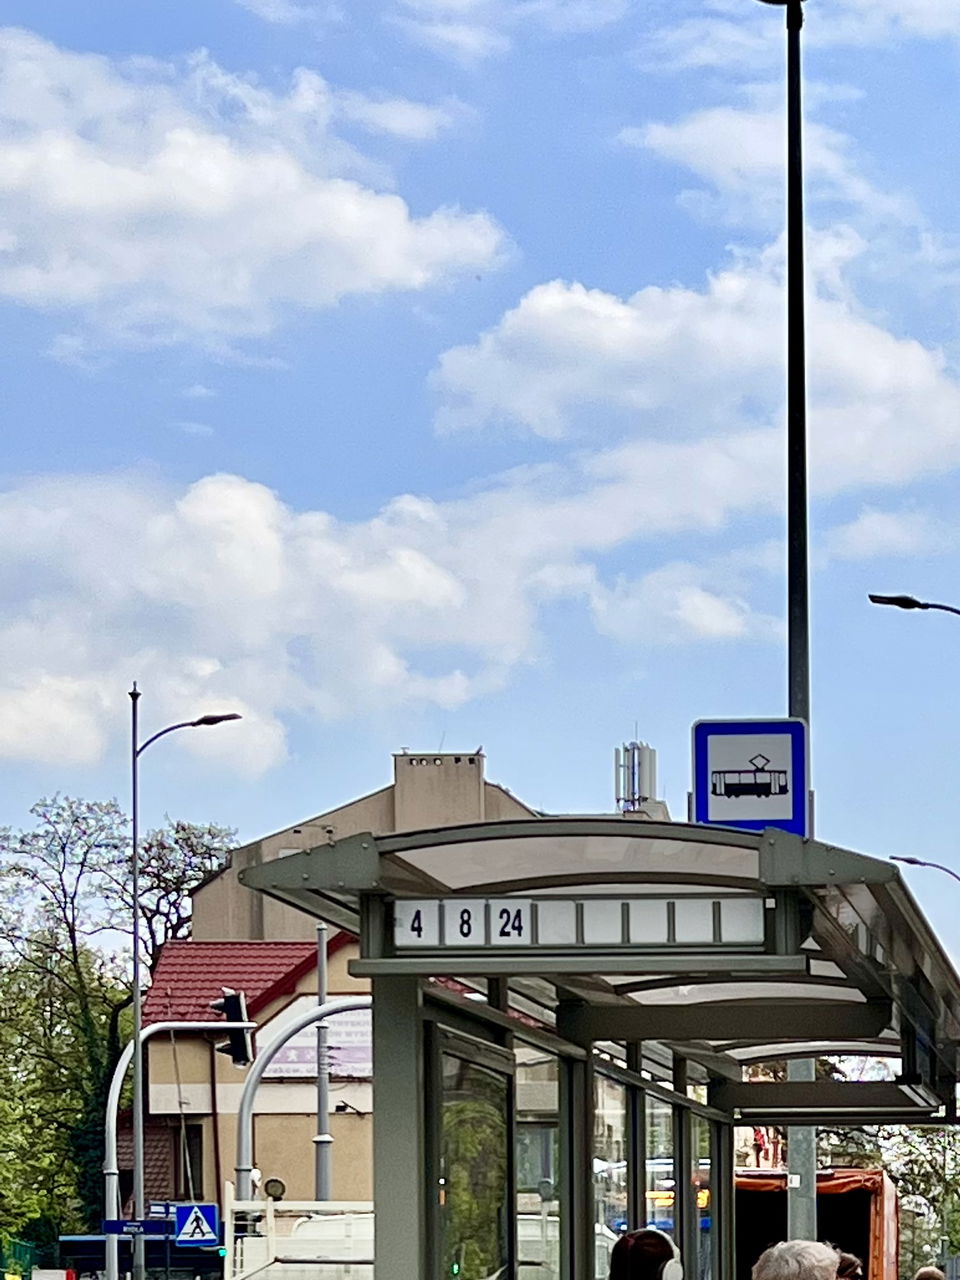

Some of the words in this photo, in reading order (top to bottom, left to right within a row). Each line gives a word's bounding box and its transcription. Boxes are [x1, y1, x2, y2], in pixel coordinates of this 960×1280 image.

[410, 909, 423, 938] 4
[459, 908, 472, 938] 8
[498, 908, 523, 938] 24
